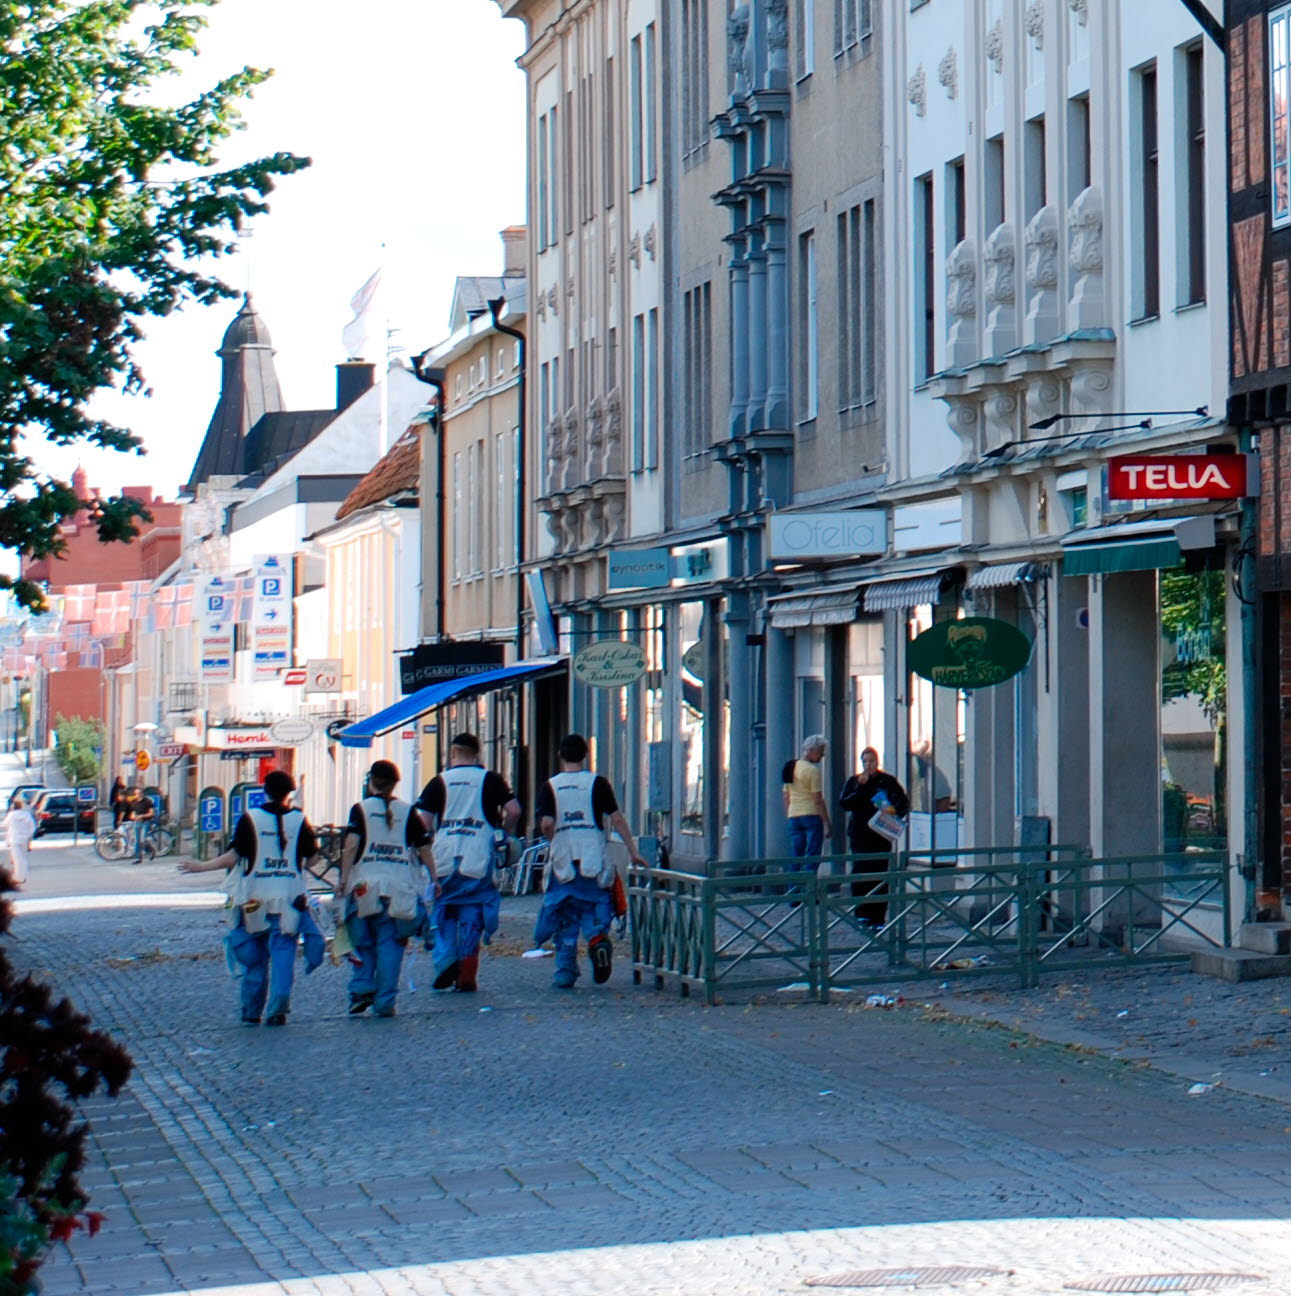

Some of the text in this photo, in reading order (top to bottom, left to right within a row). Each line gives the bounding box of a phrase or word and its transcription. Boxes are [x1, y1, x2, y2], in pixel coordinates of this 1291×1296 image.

[1119, 463, 1232, 491] TELIA
[782, 518, 875, 551] Ofelia
[227, 731, 271, 744] Hemk
